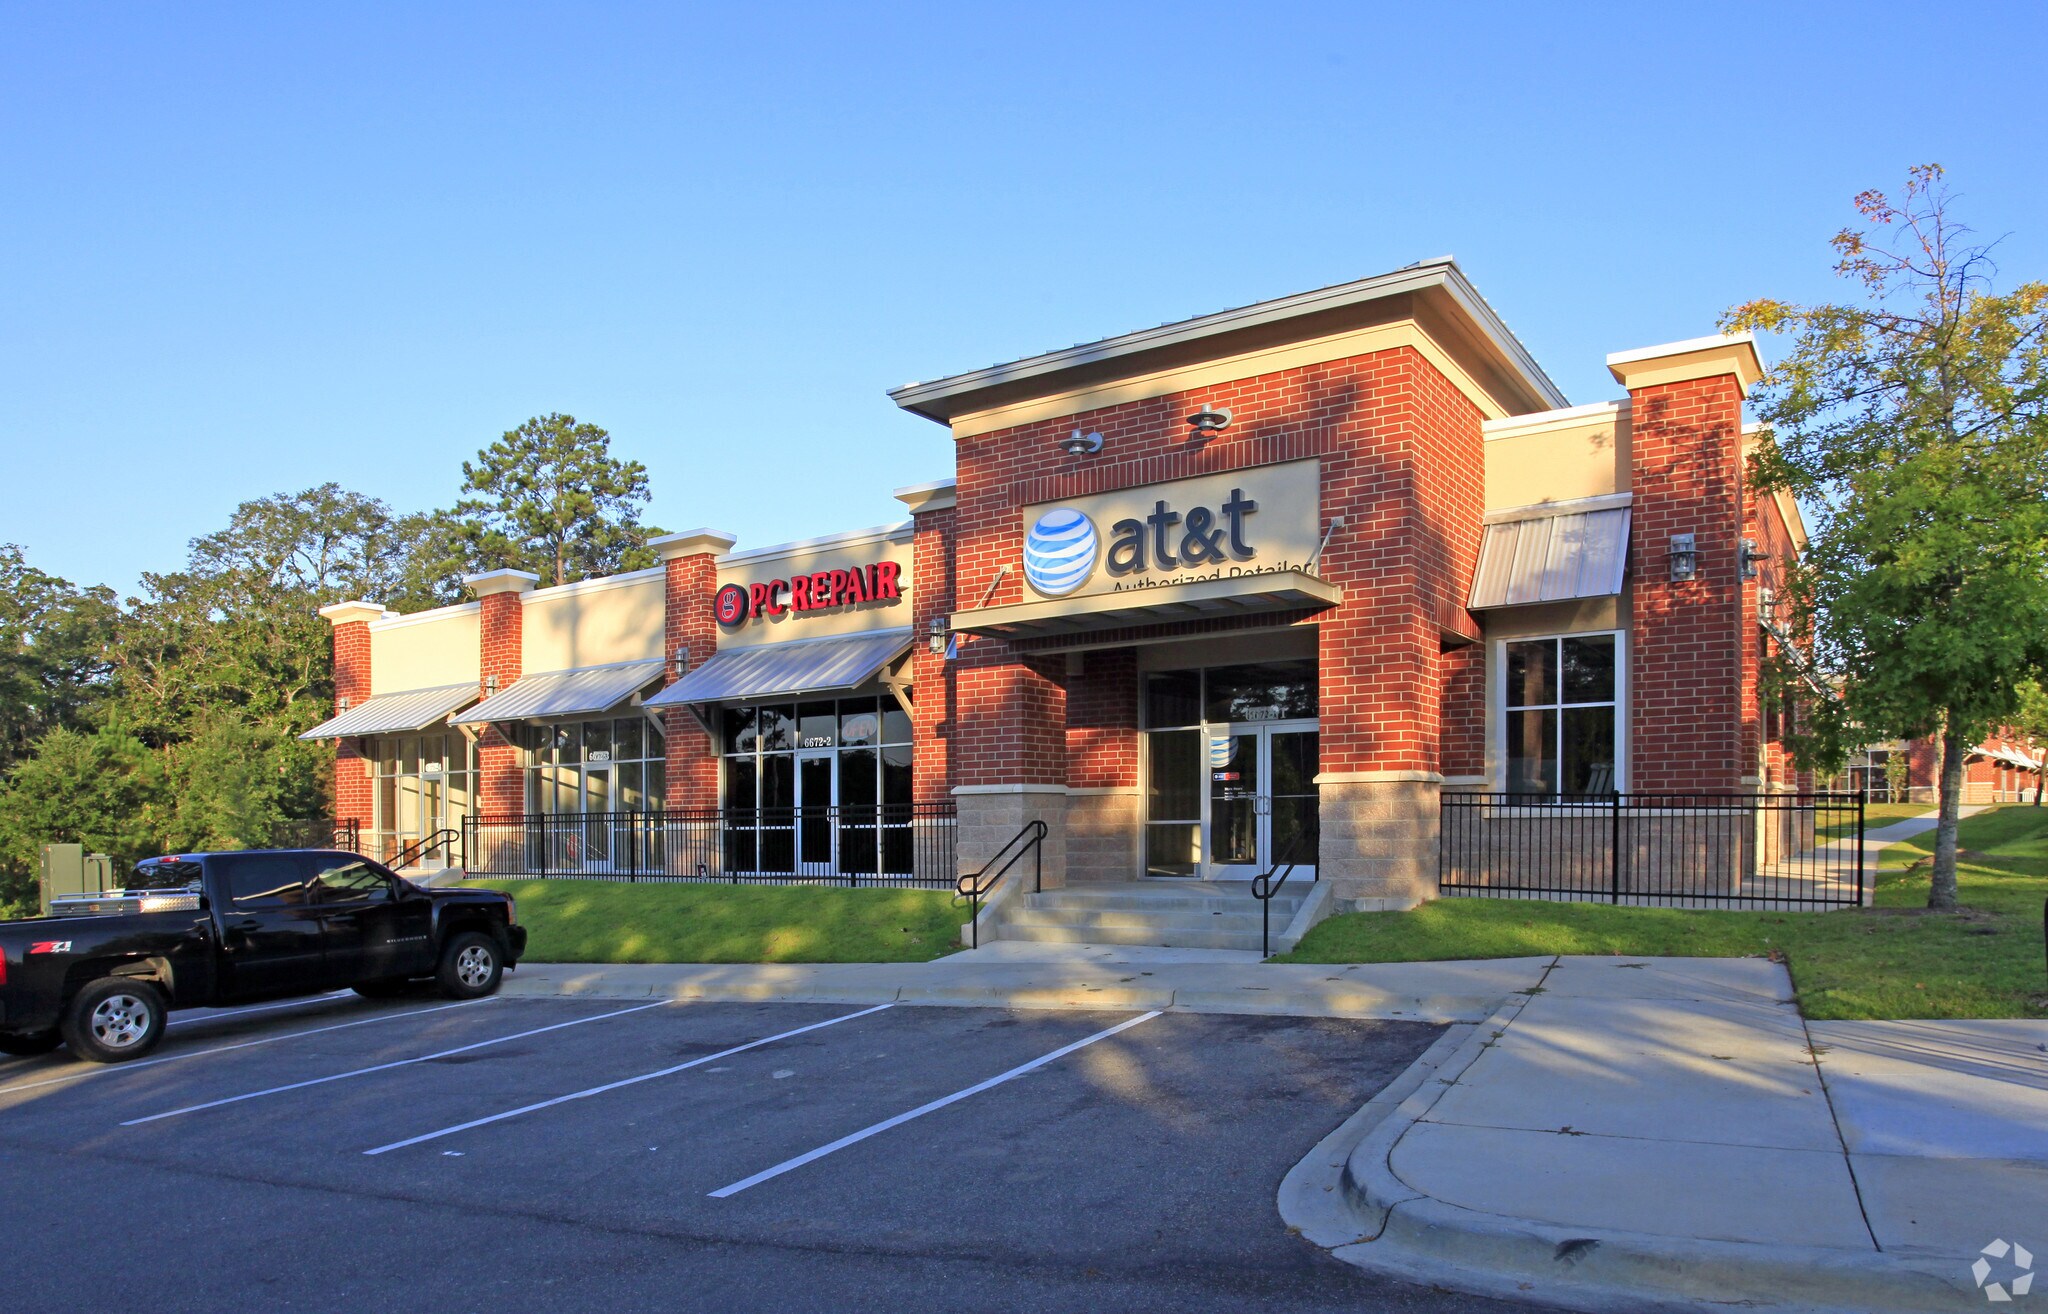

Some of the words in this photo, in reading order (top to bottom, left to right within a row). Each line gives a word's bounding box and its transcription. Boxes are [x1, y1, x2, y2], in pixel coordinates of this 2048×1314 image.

[1107, 488, 1257, 573] at&t
[749, 579, 787, 618] PC
[790, 561, 901, 611] REPAIR
[804, 736, 832, 748] 6672-2
[845, 719, 874, 737] OPEN
